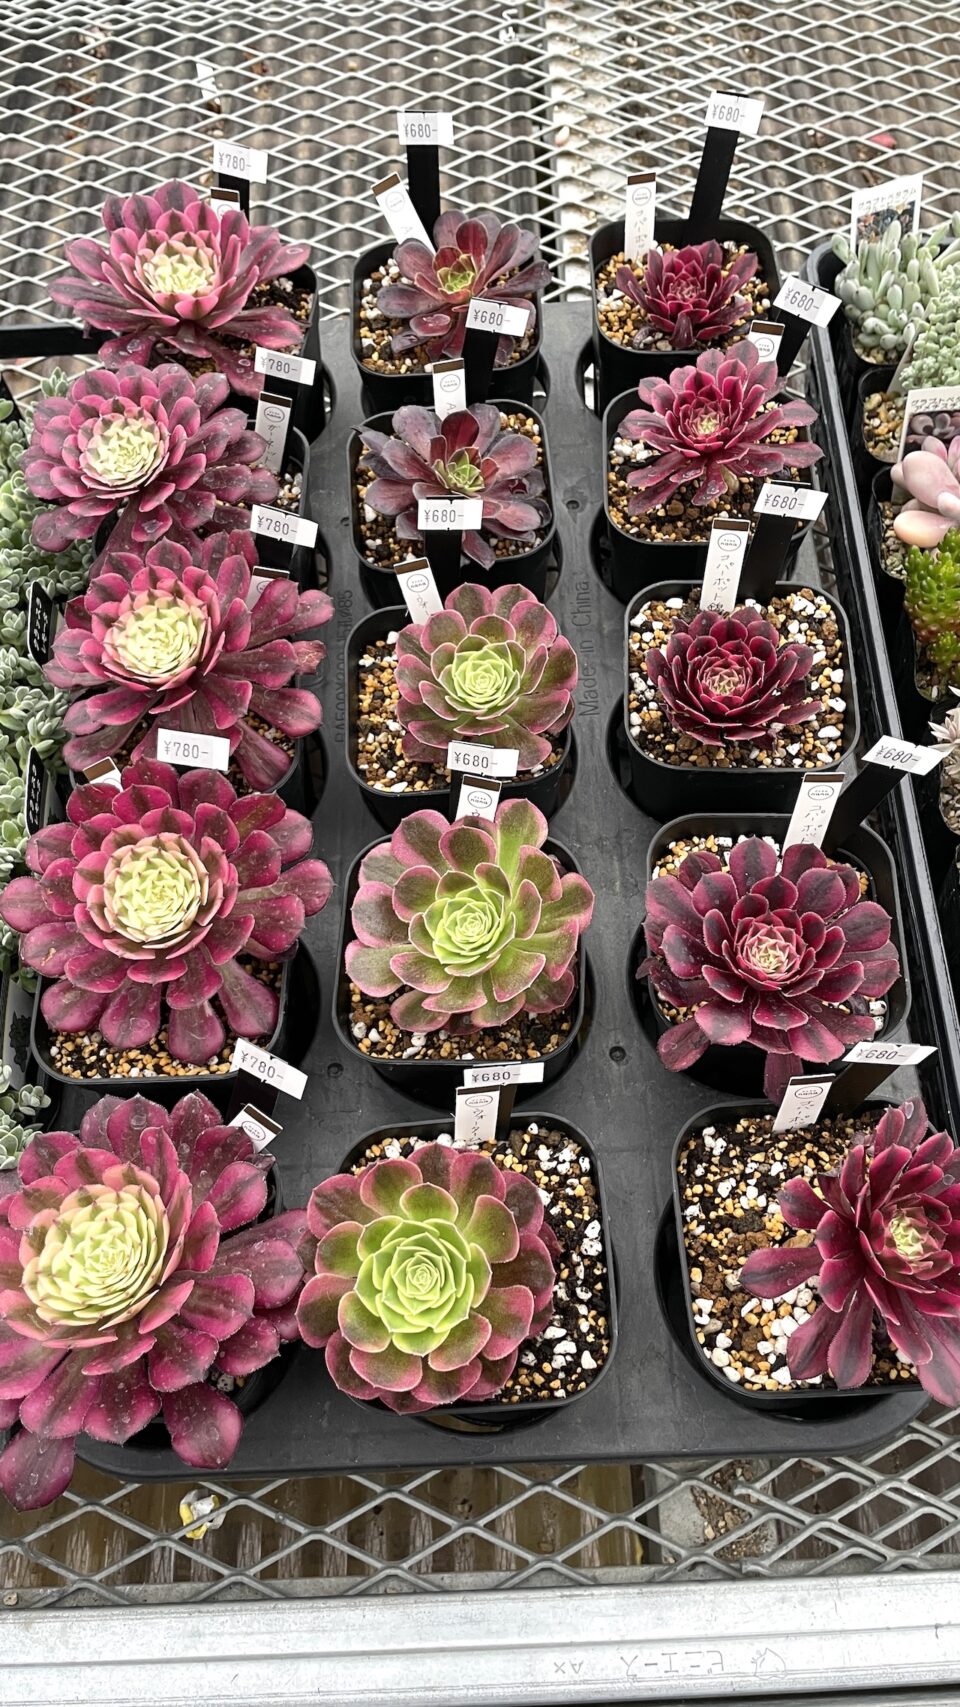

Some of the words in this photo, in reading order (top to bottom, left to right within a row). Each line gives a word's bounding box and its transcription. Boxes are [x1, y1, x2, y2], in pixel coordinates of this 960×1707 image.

[712, 104, 745, 122] ¥680-
[403, 123, 438, 138] ¥680-
[219, 152, 251, 171] ¥780-
[785, 287, 820, 311] ¥680-
[474, 309, 511, 326] ¥680-
[261, 356, 298, 374] ¥780-
[765, 493, 805, 510] ¥680-
[257, 515, 298, 535] ¥780-
[424, 509, 464, 523] ¥680-
[571, 581, 592, 628] China
[580, 639, 595, 654] in
[578, 664, 600, 717] Made
[164, 740, 209, 759] ¥780-
[876, 744, 919, 764] ¥680-
[454, 751, 498, 769] ¥680-
[856, 1049, 909, 1060] ¥680-
[241, 1050, 284, 1079] ¥780-
[472, 1071, 521, 1083] ¥680-
